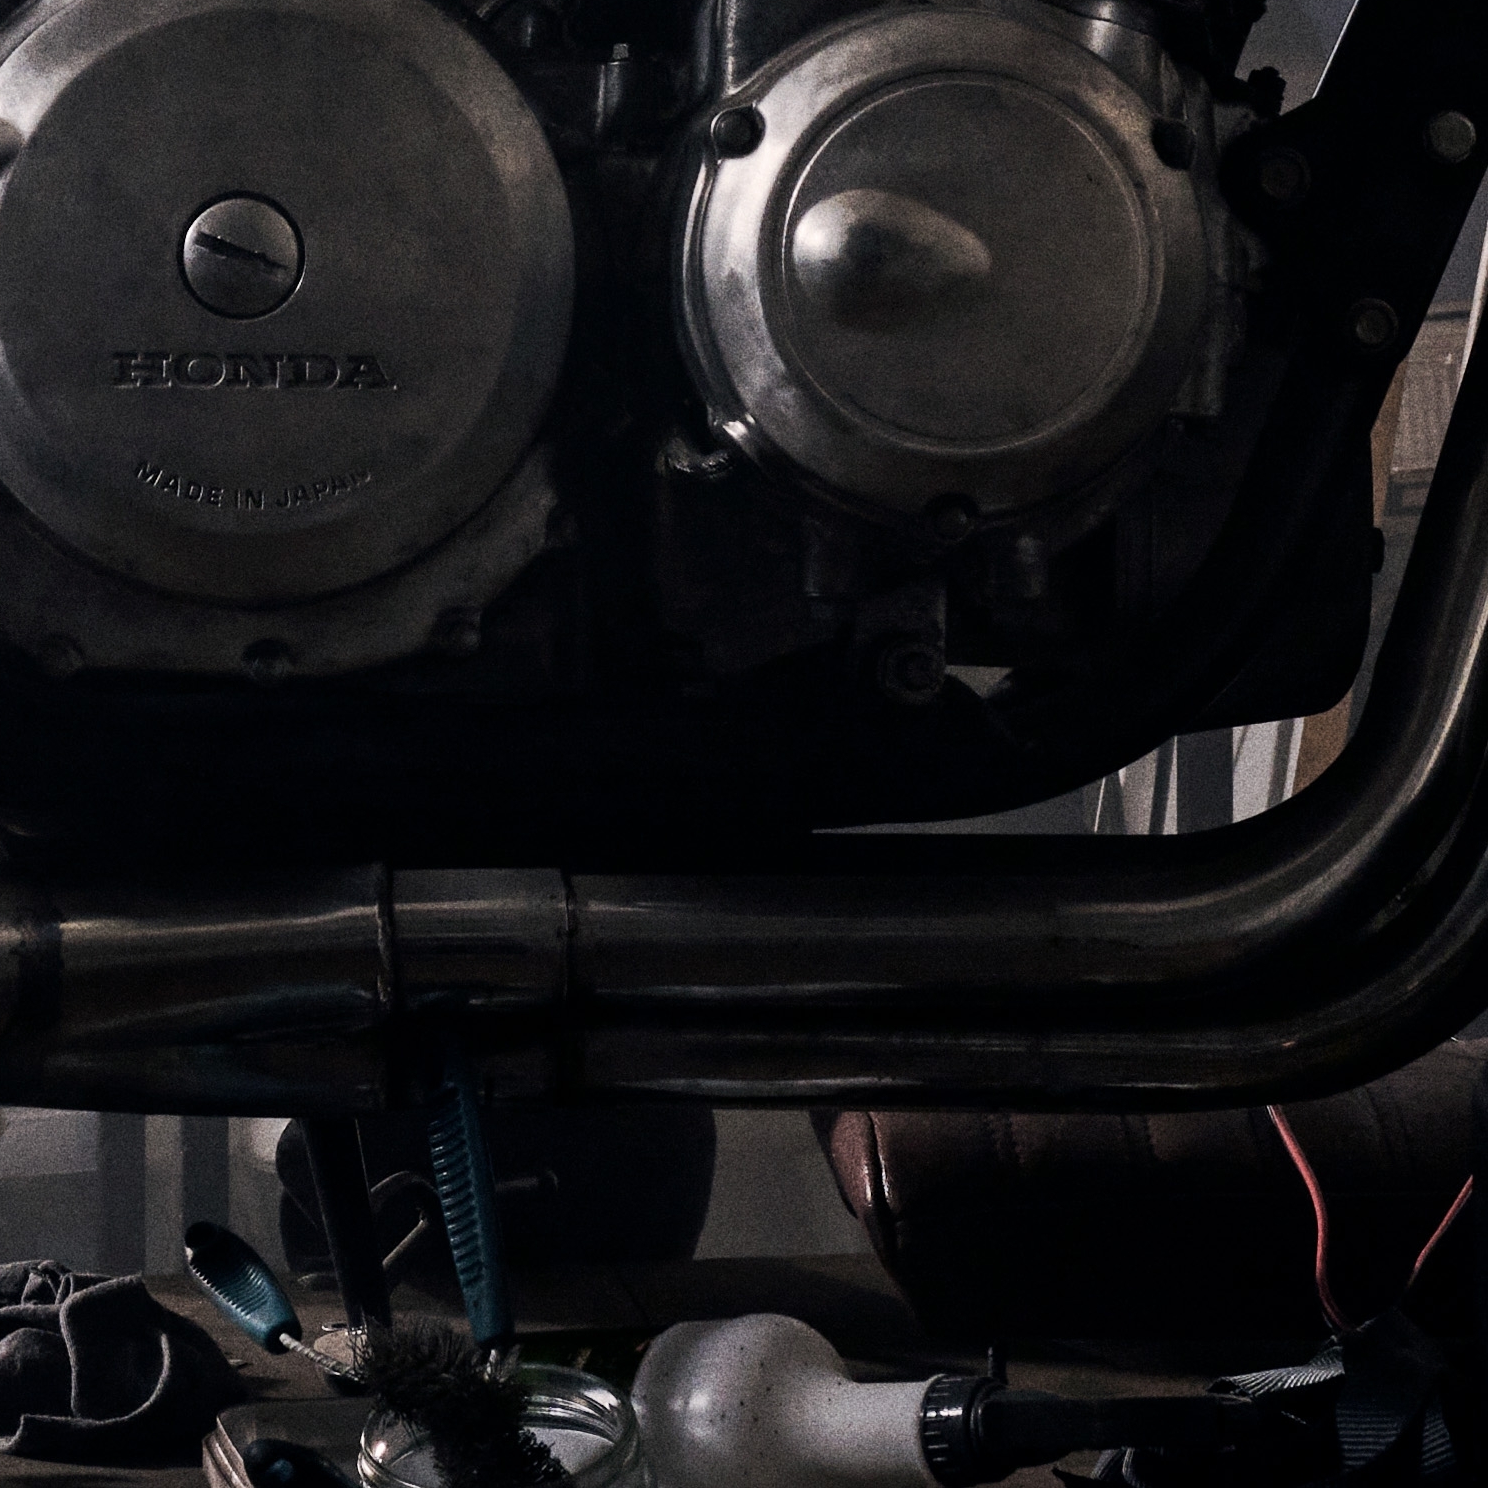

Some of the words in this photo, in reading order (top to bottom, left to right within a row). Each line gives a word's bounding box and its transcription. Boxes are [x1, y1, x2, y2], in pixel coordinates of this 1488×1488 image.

[112, 351, 398, 389] HONDA
[135, 460, 225, 507] MADE
[234, 488, 266, 510] IN
[276, 471, 373, 509] JAPAN
